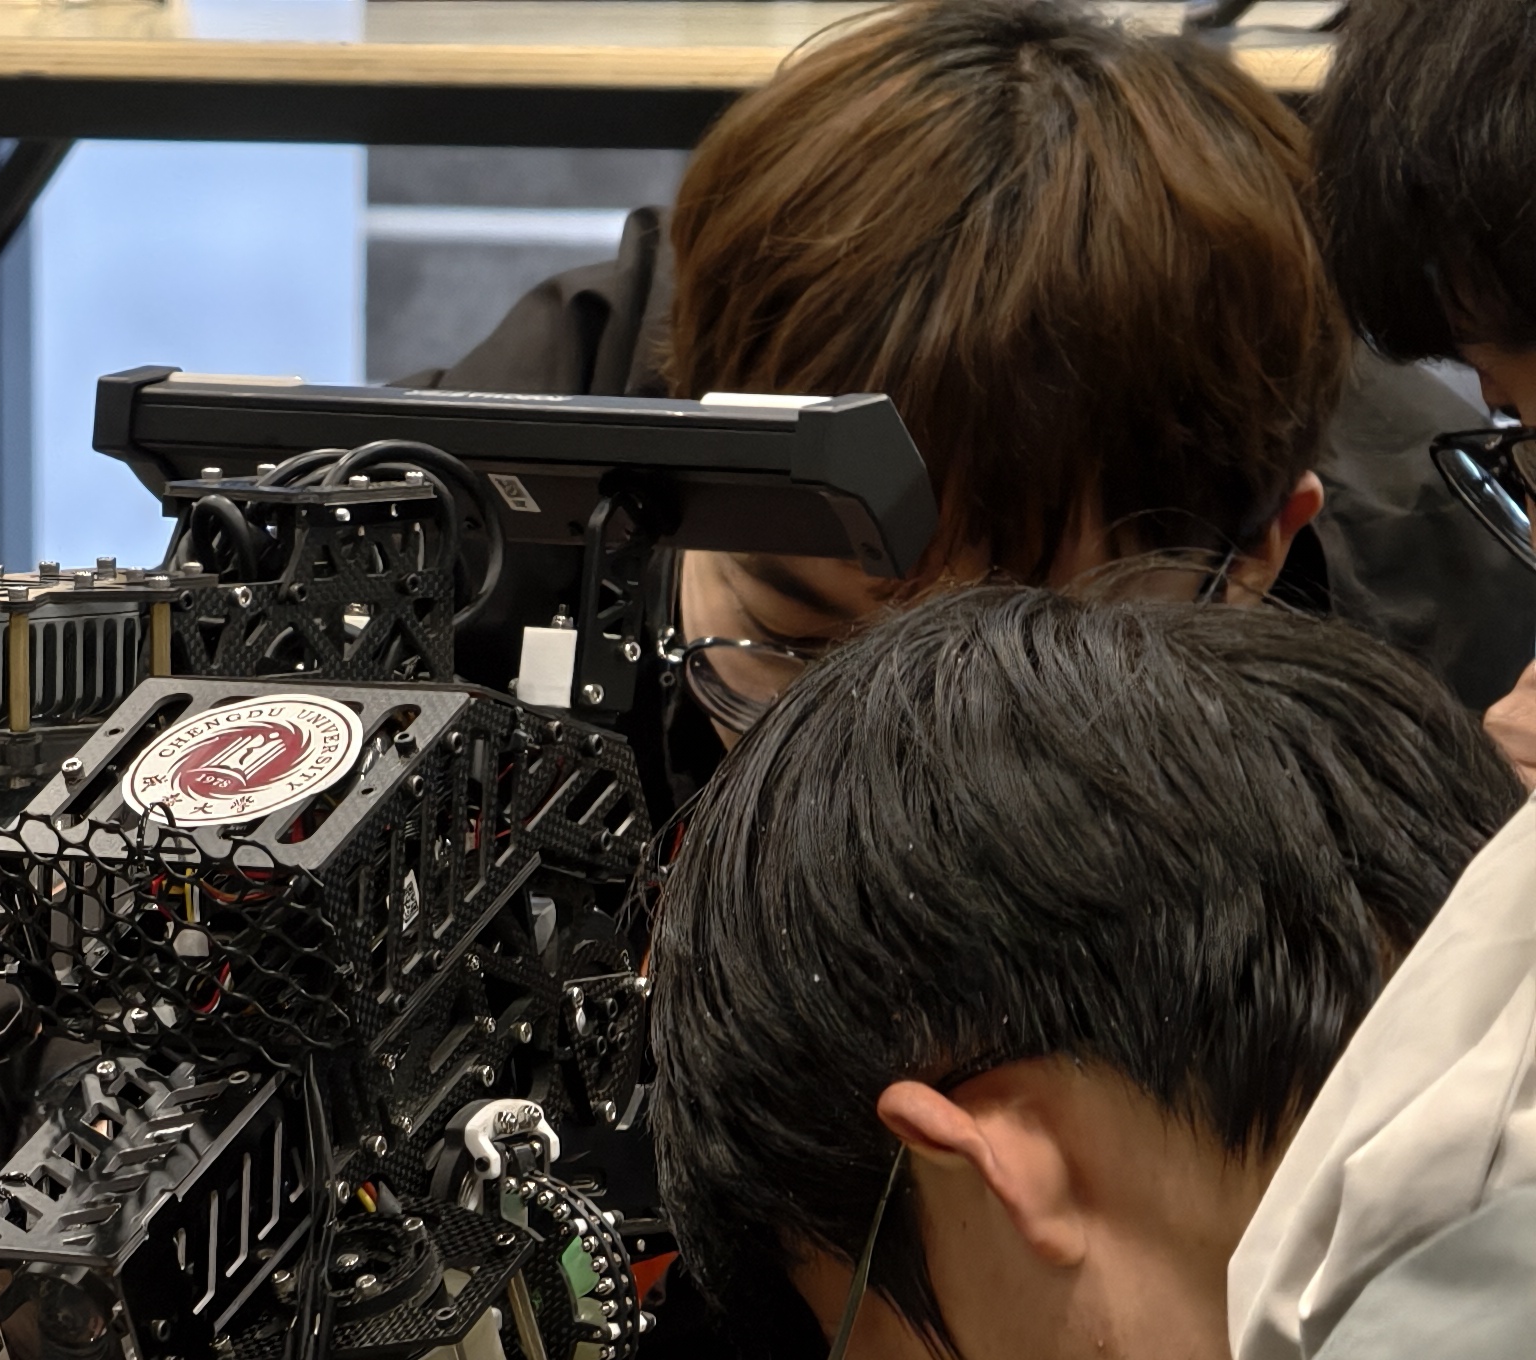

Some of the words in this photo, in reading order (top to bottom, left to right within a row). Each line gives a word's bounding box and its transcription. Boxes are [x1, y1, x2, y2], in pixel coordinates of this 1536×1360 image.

[158, 706, 286, 759] CHENGDU
[288, 707, 340, 792] UNIVERSITY
[194, 772, 232, 788] 1978
